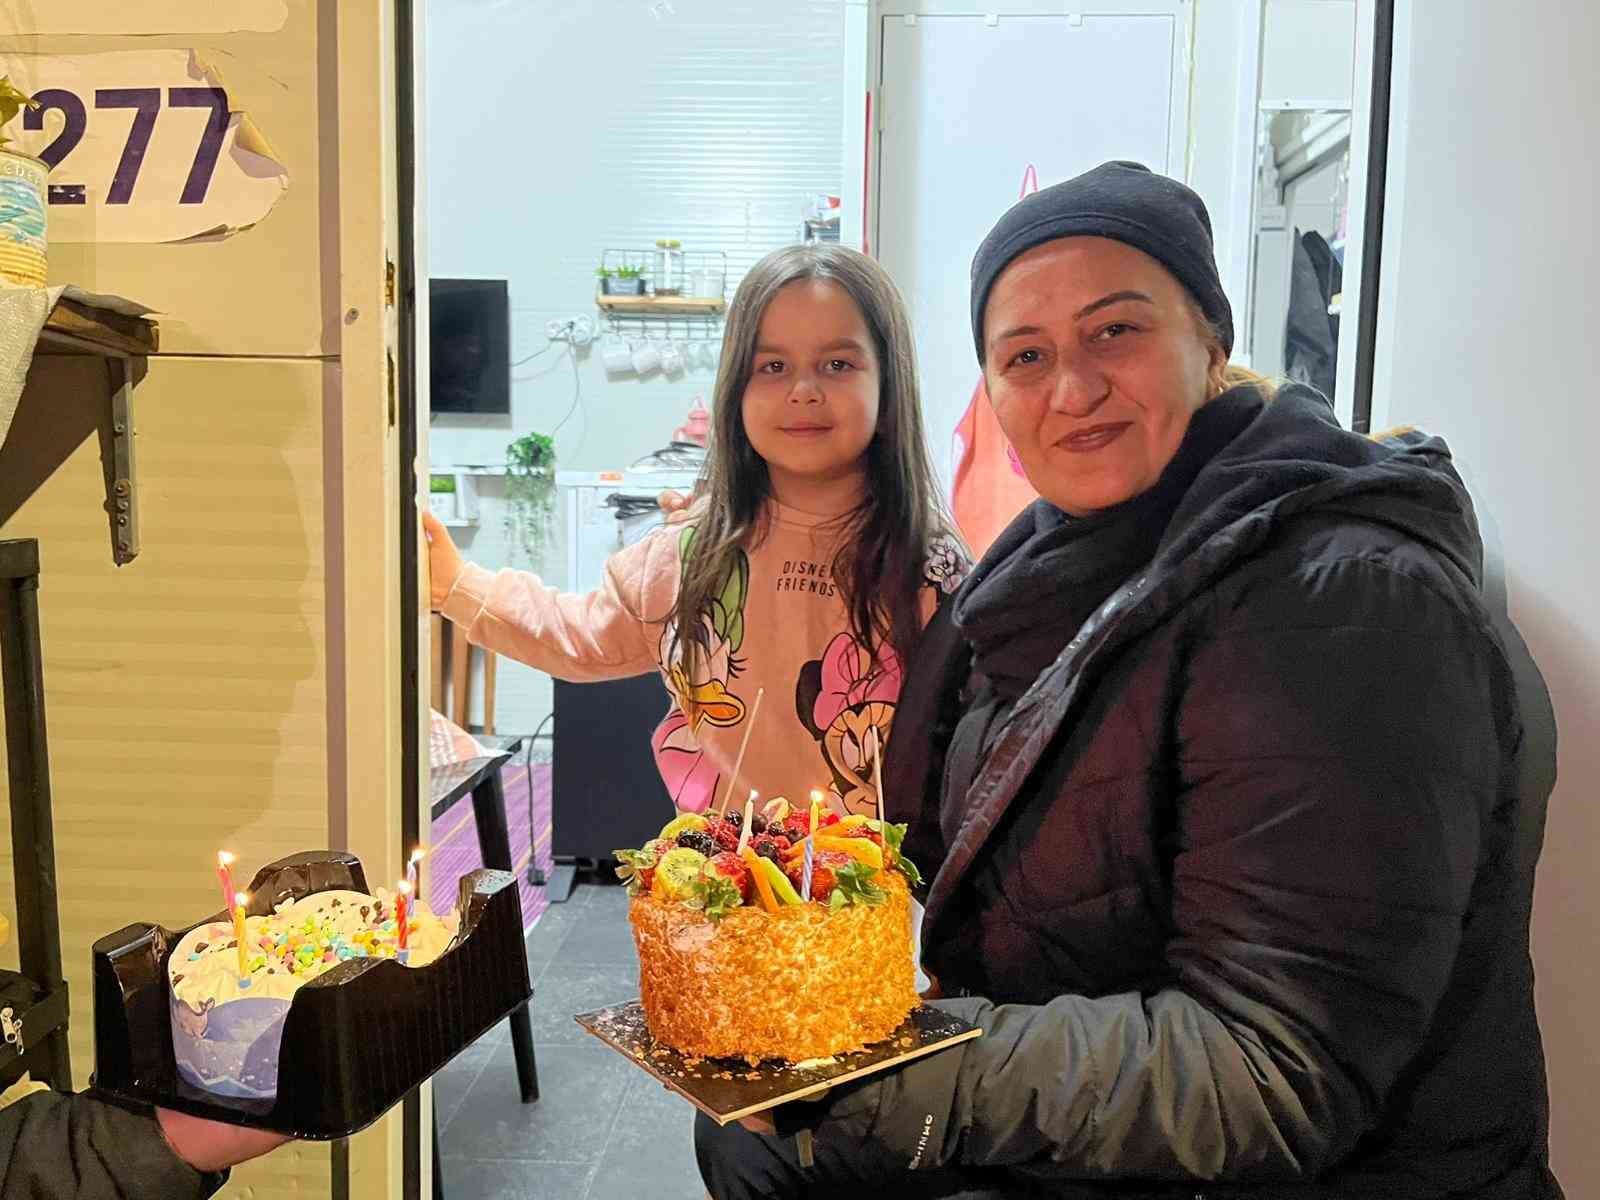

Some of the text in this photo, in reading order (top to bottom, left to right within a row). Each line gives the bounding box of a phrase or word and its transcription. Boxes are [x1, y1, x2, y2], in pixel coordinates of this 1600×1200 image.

[23, 87, 232, 205] 277
[783, 560, 832, 577] DISNE
[776, 577, 837, 597] FRIENDS
